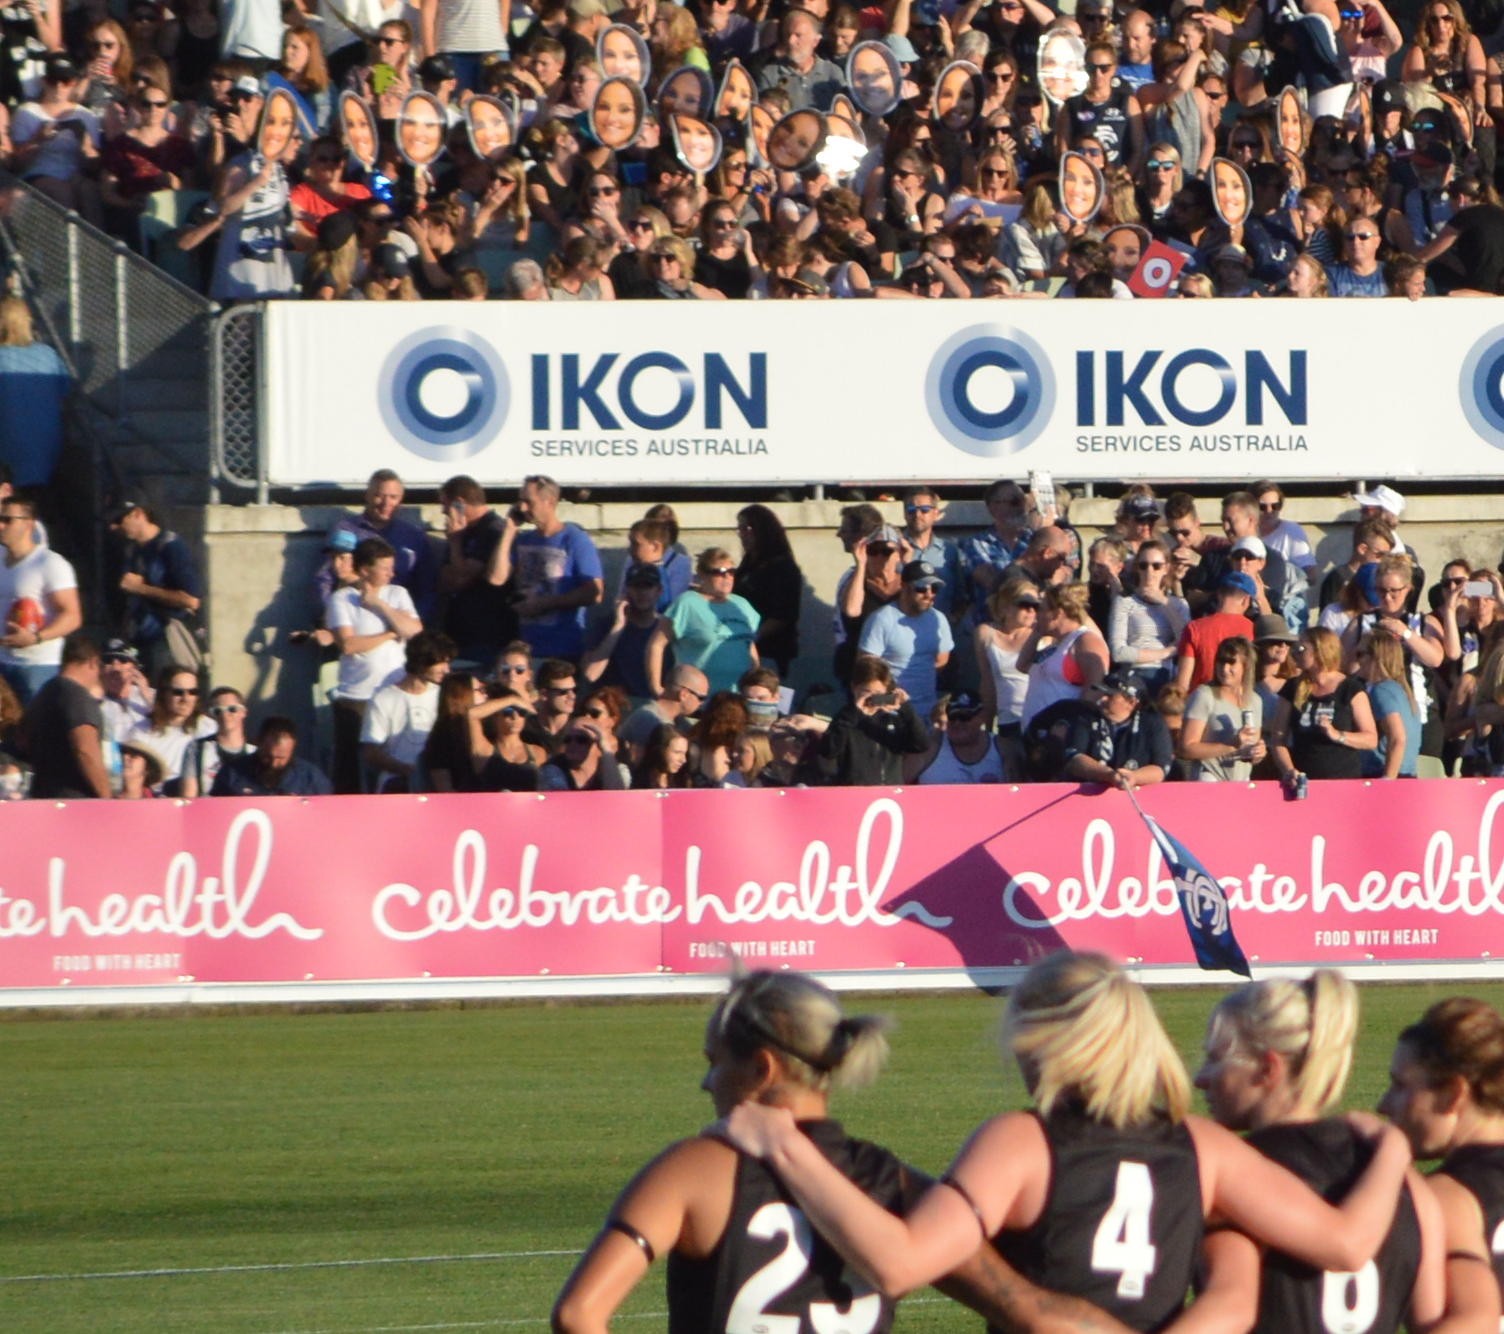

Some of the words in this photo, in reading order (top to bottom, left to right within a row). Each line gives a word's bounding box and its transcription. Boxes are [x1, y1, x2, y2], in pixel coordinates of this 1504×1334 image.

[531, 351, 768, 430] IKON
[1077, 348, 1307, 427] IKON
[531, 439, 638, 457] SERVICES
[647, 438, 768, 456] AUSTRALIA
[1077, 434, 1181, 453] SERVICES
[1189, 433, 1309, 452] AUSTRALIA
[1315, 931, 1352, 947] FOOD
[1355, 930, 1390, 946] WITH
[1394, 928, 1438, 945] HEART
[690, 942, 727, 959] FOOD
[730, 941, 766, 957] WITH
[770, 940, 816, 956] HEART
[54, 955, 90, 971] FOOD
[94, 954, 131, 970] WITH
[135, 953, 182, 969] HEART
[1091, 1160, 1155, 1299] 4
